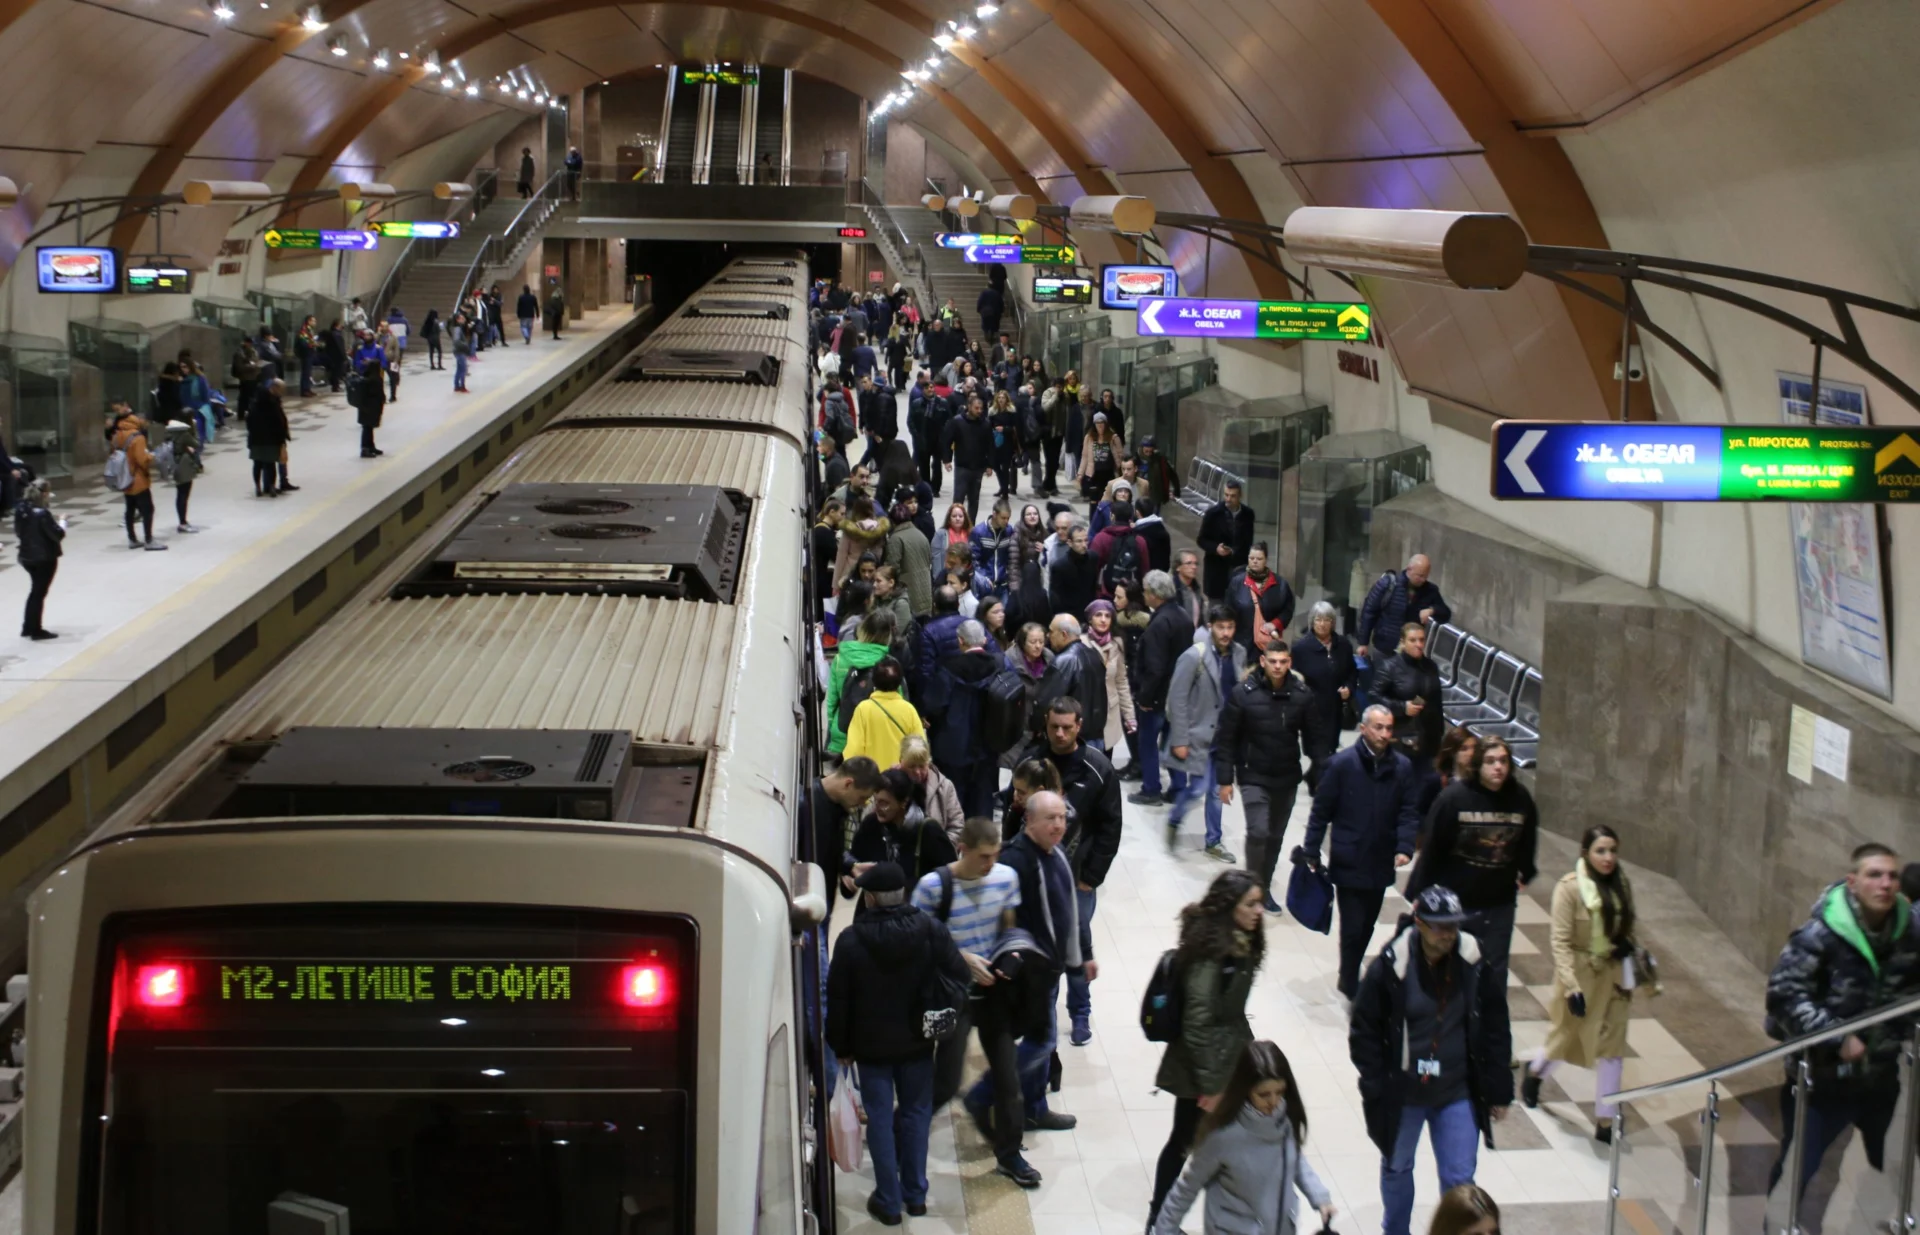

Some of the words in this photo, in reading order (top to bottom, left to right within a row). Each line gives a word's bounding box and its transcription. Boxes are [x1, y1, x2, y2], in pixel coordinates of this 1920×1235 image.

[1203, 308, 1242, 319] ОБЕЛЯ
[1194, 320, 1225, 328] OBELYA
[1339, 326, 1365, 334] ИЗХОД
[1729, 438, 1745, 450] ул.
[1748, 437, 1810, 449] ПИРОТСКА
[1819, 440, 1859, 449] PIROTSKA
[1622, 443, 1696, 464] ОБЕЛЯ
[1889, 490, 1910, 499] EXIT
[220, 965, 435, 1002] М2-ЛЕТИЩЕ
[451, 963, 571, 1002] СОФИЯ
